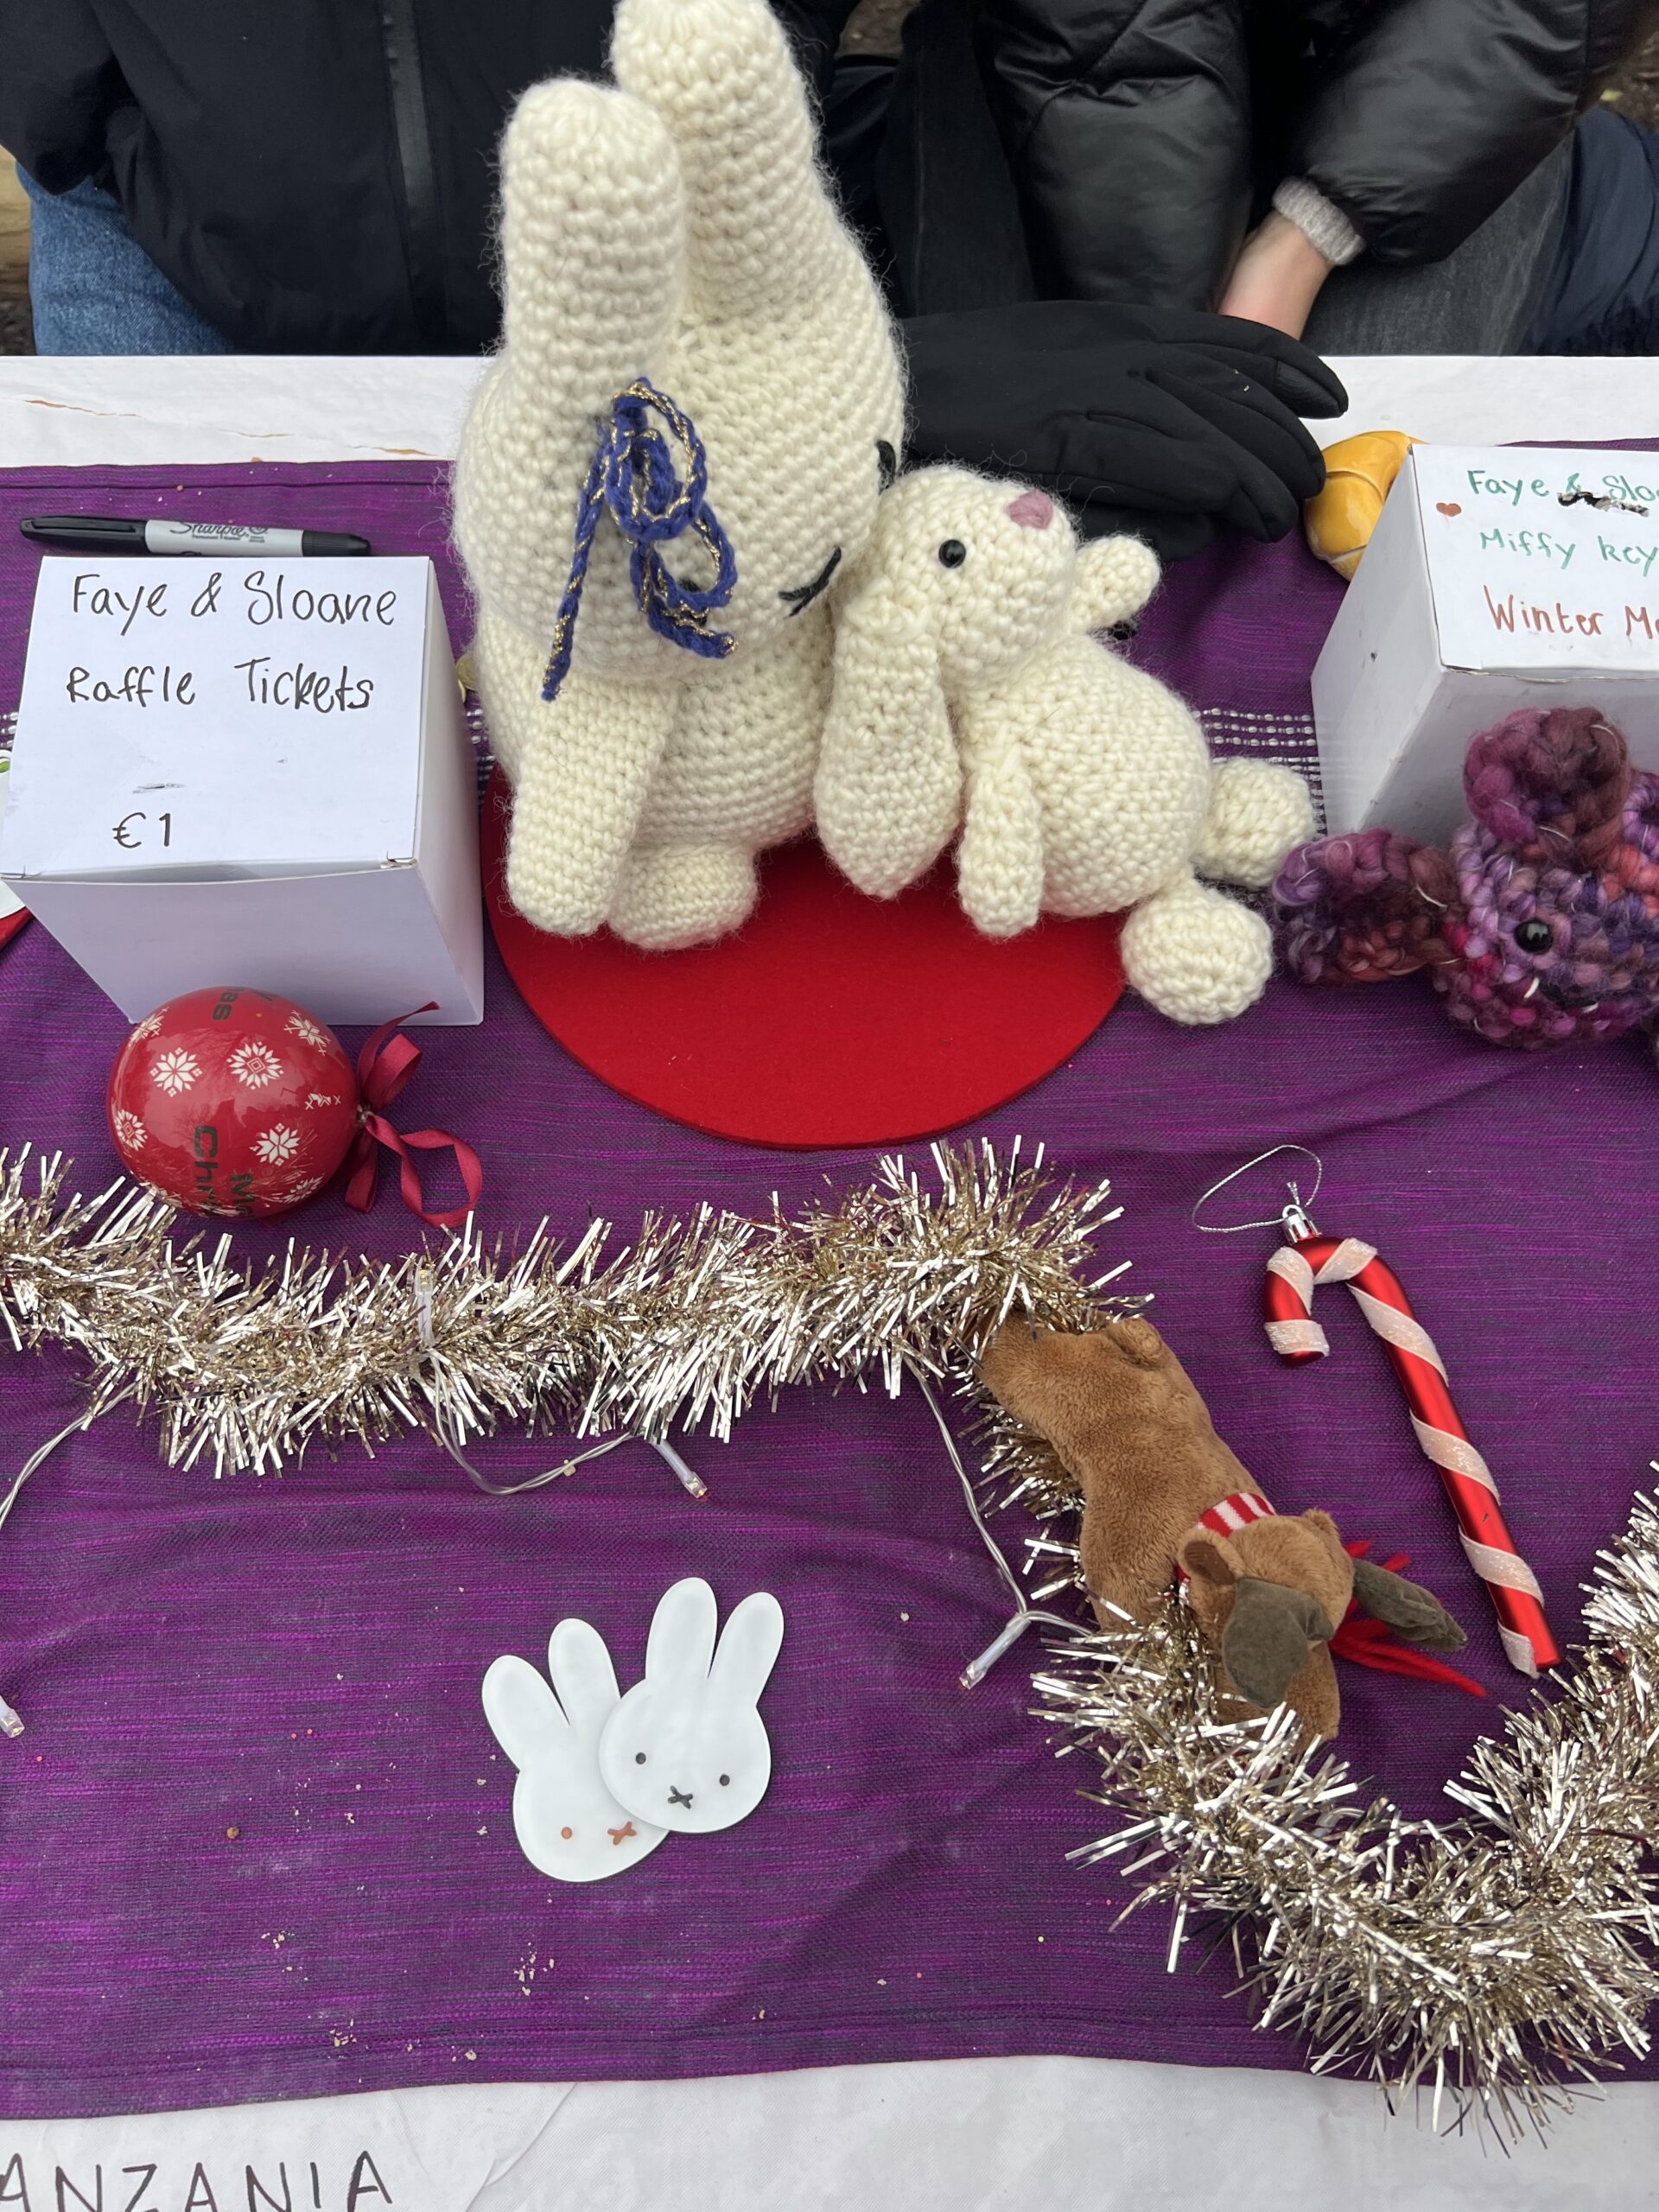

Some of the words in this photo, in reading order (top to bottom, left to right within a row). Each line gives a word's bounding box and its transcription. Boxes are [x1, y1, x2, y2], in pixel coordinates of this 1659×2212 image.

[1467, 470, 1550, 506] Faye
[1566, 473, 1582, 493] &
[1601, 475, 1659, 502] Slo
[1480, 528, 1576, 569] Miffy
[1597, 535, 1659, 577] key
[73, 573, 168, 636] Faye
[190, 571, 223, 617] &
[244, 569, 397, 626] Sloane
[1484, 584, 1605, 635] Winter
[1624, 605, 1659, 639] M
[67, 666, 196, 708] Raffle
[234, 656, 374, 714] Tickets
[111, 811, 171, 849] €1
